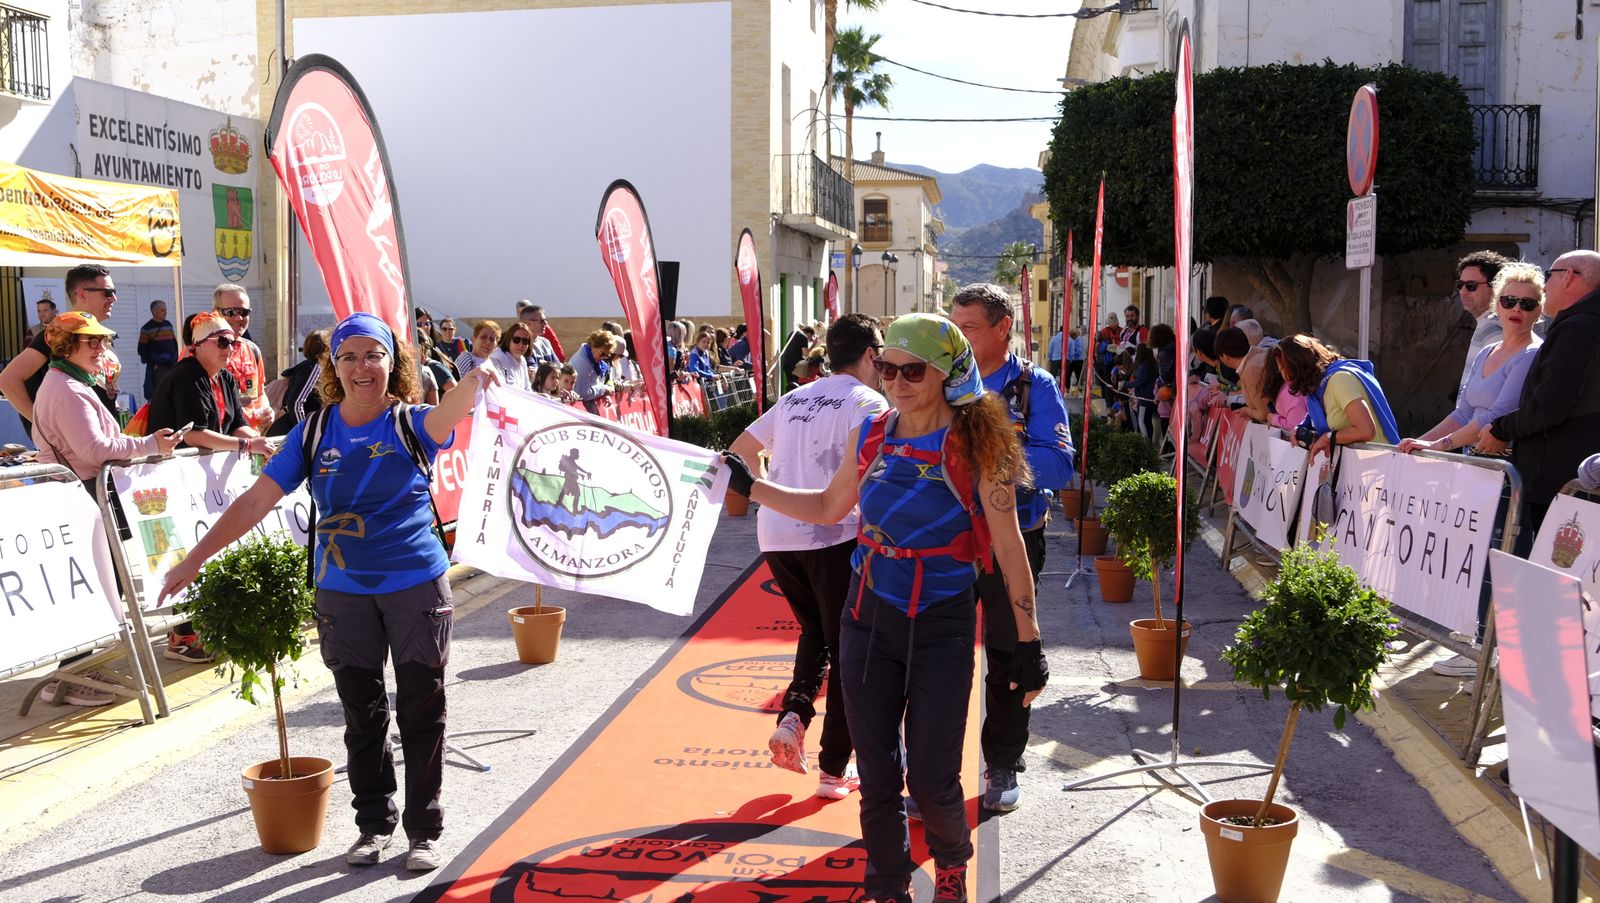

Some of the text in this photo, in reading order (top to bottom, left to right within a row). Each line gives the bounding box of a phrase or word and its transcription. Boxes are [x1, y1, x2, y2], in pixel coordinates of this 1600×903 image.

[89, 113, 201, 156] EXCELENTÍSIMO
[94, 153, 203, 190] AYUNTAMIENTO
[528, 429, 666, 499] CLUB SENDEROS
[476, 434, 503, 545] ALMERÍA
[41, 524, 73, 550] DE
[665, 489, 699, 589] ANDALUCÍA
[1454, 507, 1479, 532] DE
[530, 535, 645, 569] ALMANZORA
